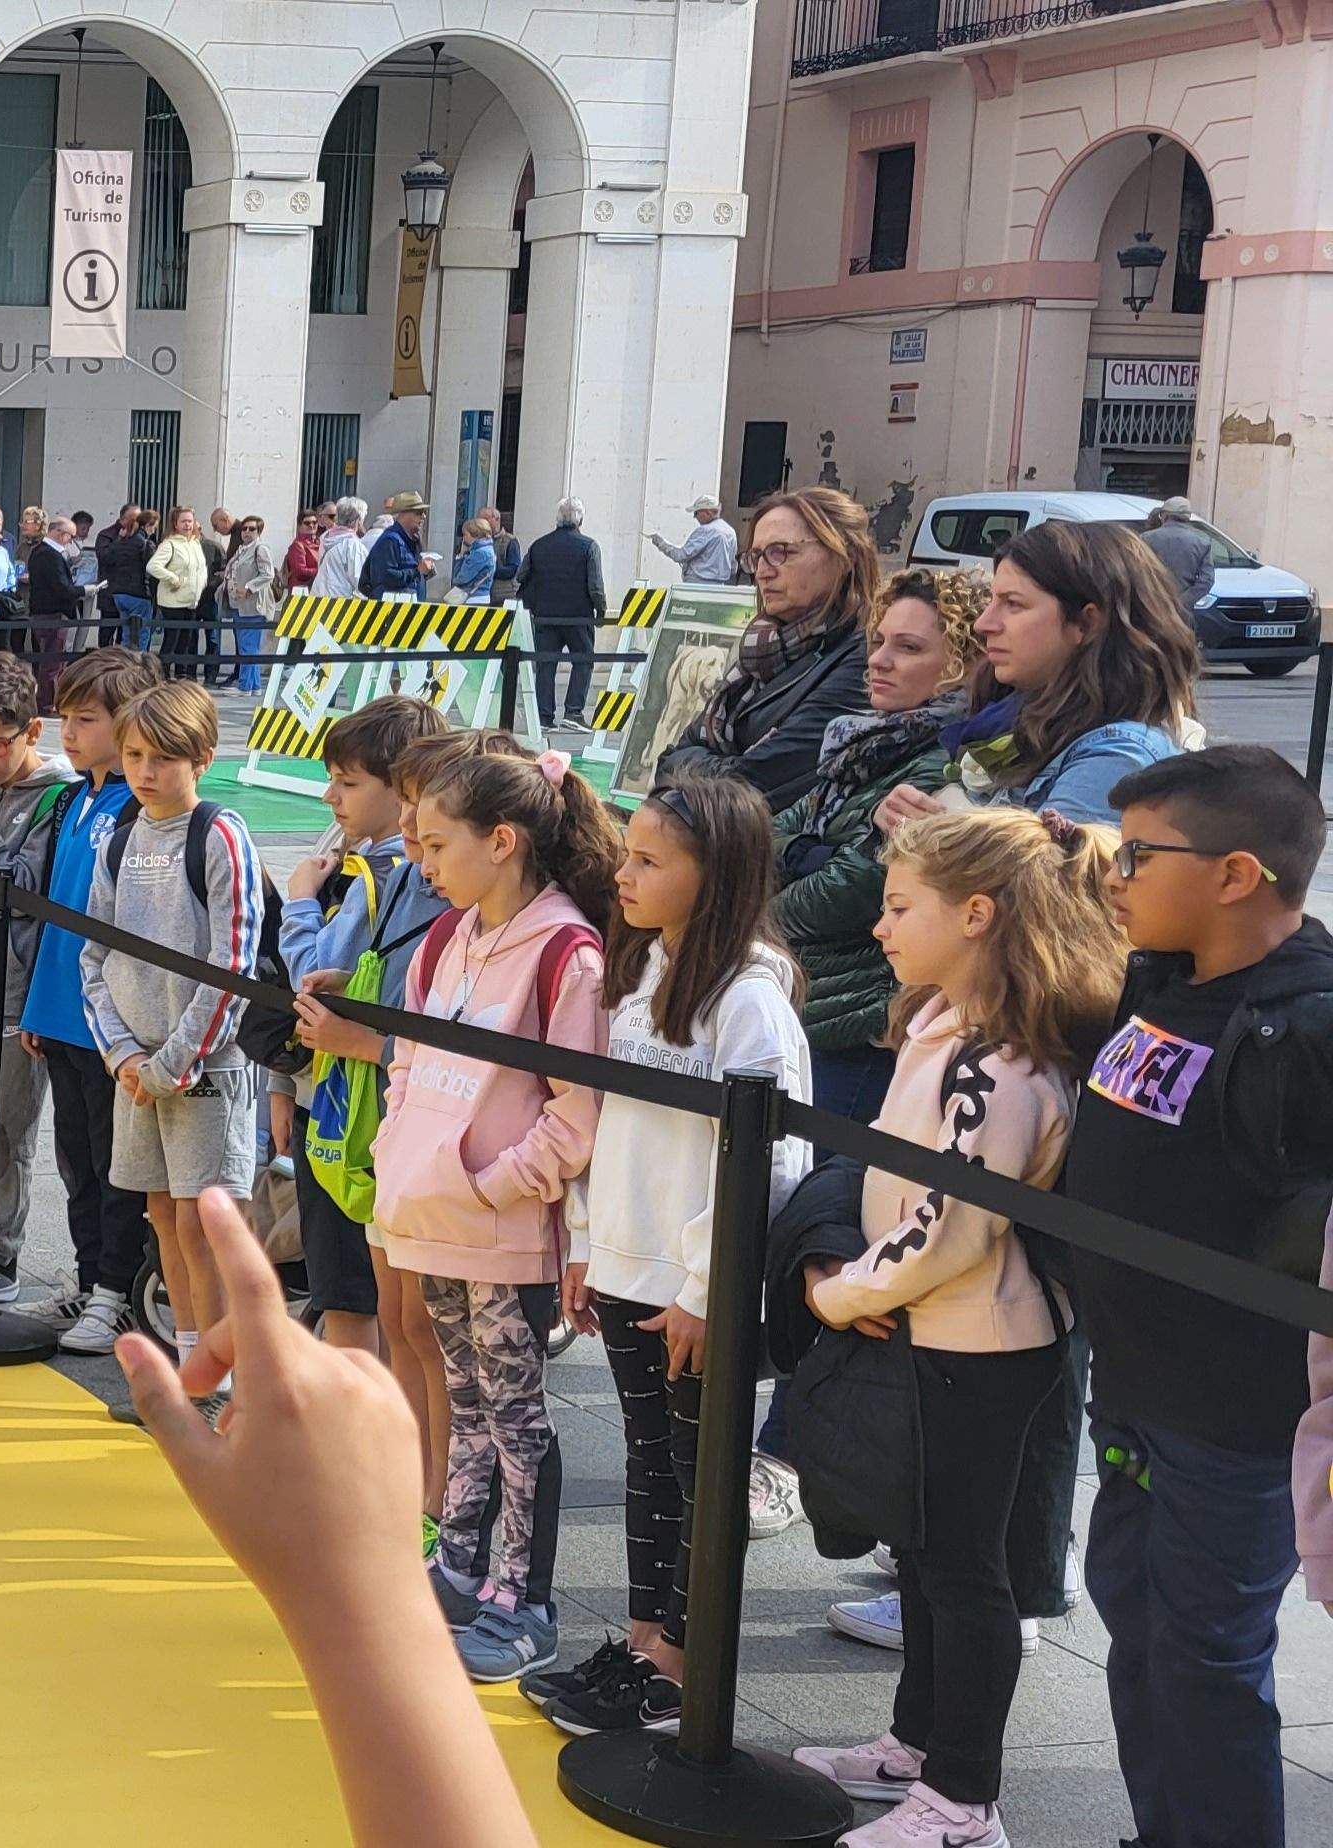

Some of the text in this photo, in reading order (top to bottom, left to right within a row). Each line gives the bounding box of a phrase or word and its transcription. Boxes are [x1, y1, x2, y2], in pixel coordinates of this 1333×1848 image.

[72, 169, 125, 186] Oficina
[104, 189, 123, 205] de
[63, 207, 123, 223] Turismo
[1252, 626, 1275, 636] 2103
[409, 1061, 480, 1101] adidas
